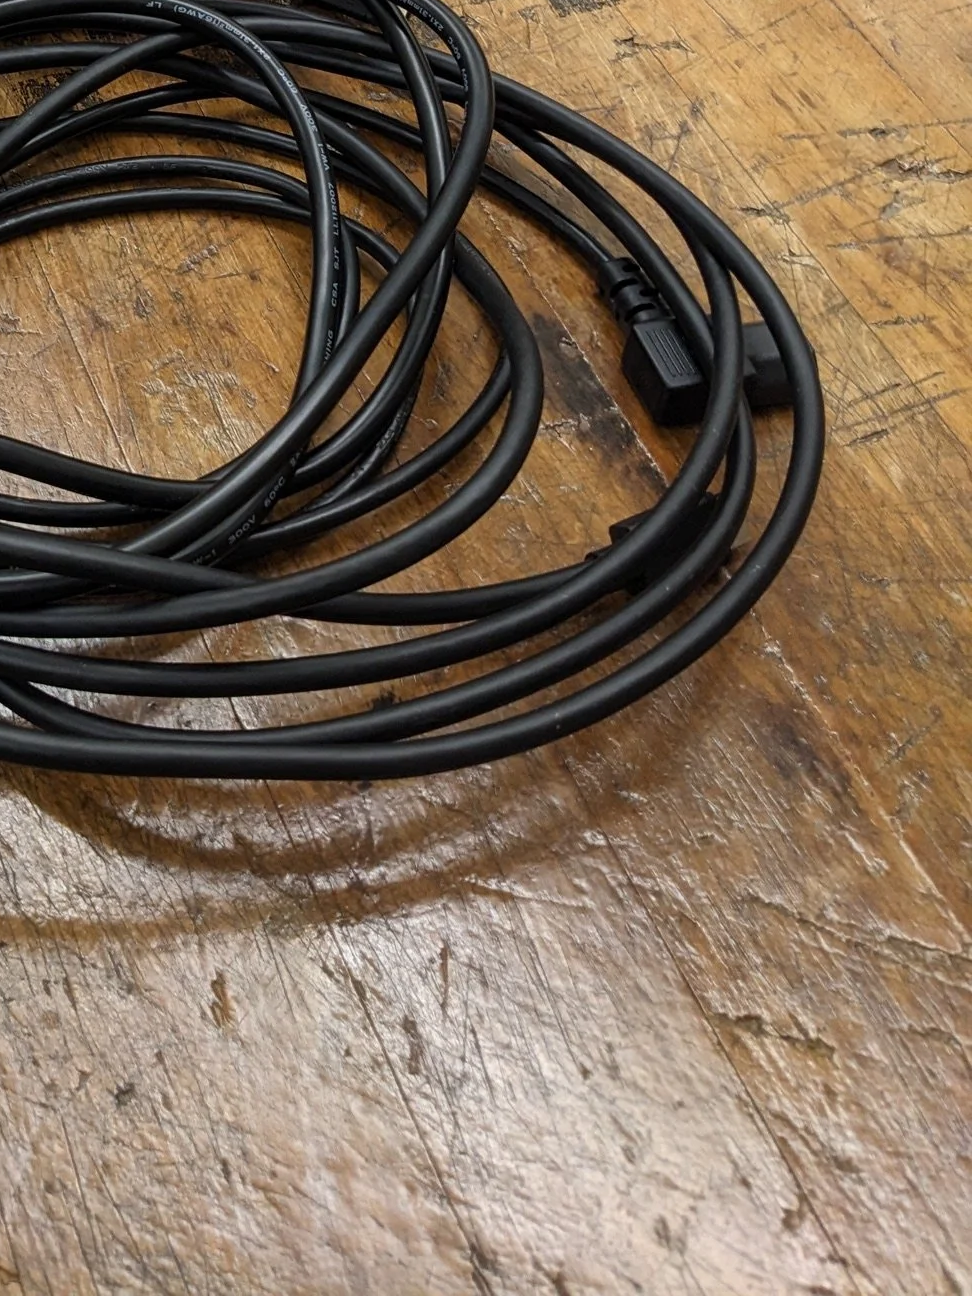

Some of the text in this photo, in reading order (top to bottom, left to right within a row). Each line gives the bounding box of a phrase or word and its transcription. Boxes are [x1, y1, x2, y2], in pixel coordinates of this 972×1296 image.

[145, 0, 163, 9] LF
[300, 103, 319, 133] 300V
[317, 142, 330, 172] VW-1
[327, 183, 341, 237] LL112007
[333, 248, 341, 271] SJT
[331, 282, 339, 307] CSA
[228, 514, 256, 545] 300V
